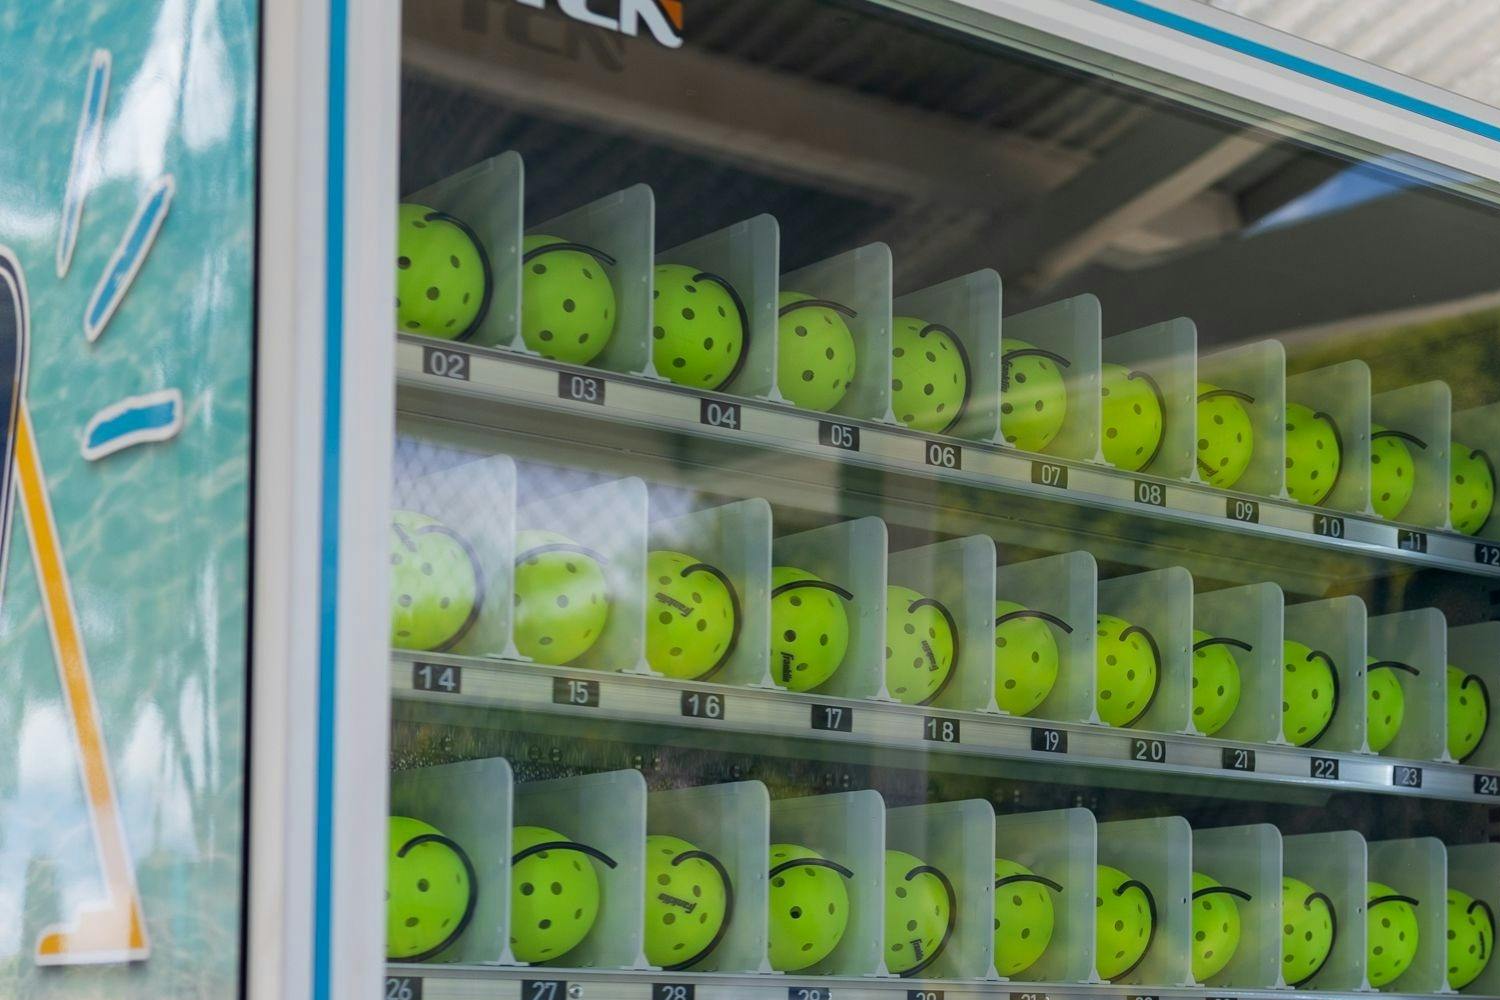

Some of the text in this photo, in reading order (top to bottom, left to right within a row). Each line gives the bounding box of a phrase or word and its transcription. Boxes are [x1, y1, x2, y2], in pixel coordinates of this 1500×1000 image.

[430, 351, 465, 380] 02
[571, 376, 597, 401] 03
[707, 403, 737, 429] 04
[830, 423, 853, 448] 05
[929, 443, 955, 469] 06
[1041, 464, 1060, 486] 07
[1138, 482, 1161, 505] 08
[1235, 500, 1253, 521] 09
[1319, 516, 1341, 538] 10
[1410, 531, 1421, 550] 11
[1480, 546, 1500, 566] 12
[418, 665, 456, 692] 14
[567, 680, 589, 704] 15
[688, 694, 721, 718] 16
[825, 707, 843, 730] 17
[927, 718, 954, 743] 18
[1044, 730, 1059, 751] 19
[1136, 740, 1162, 761] 20
[1234, 750, 1248, 769] 21
[1314, 759, 1336, 778] 22
[1401, 767, 1418, 786] 23
[1479, 776, 1498, 794] 24
